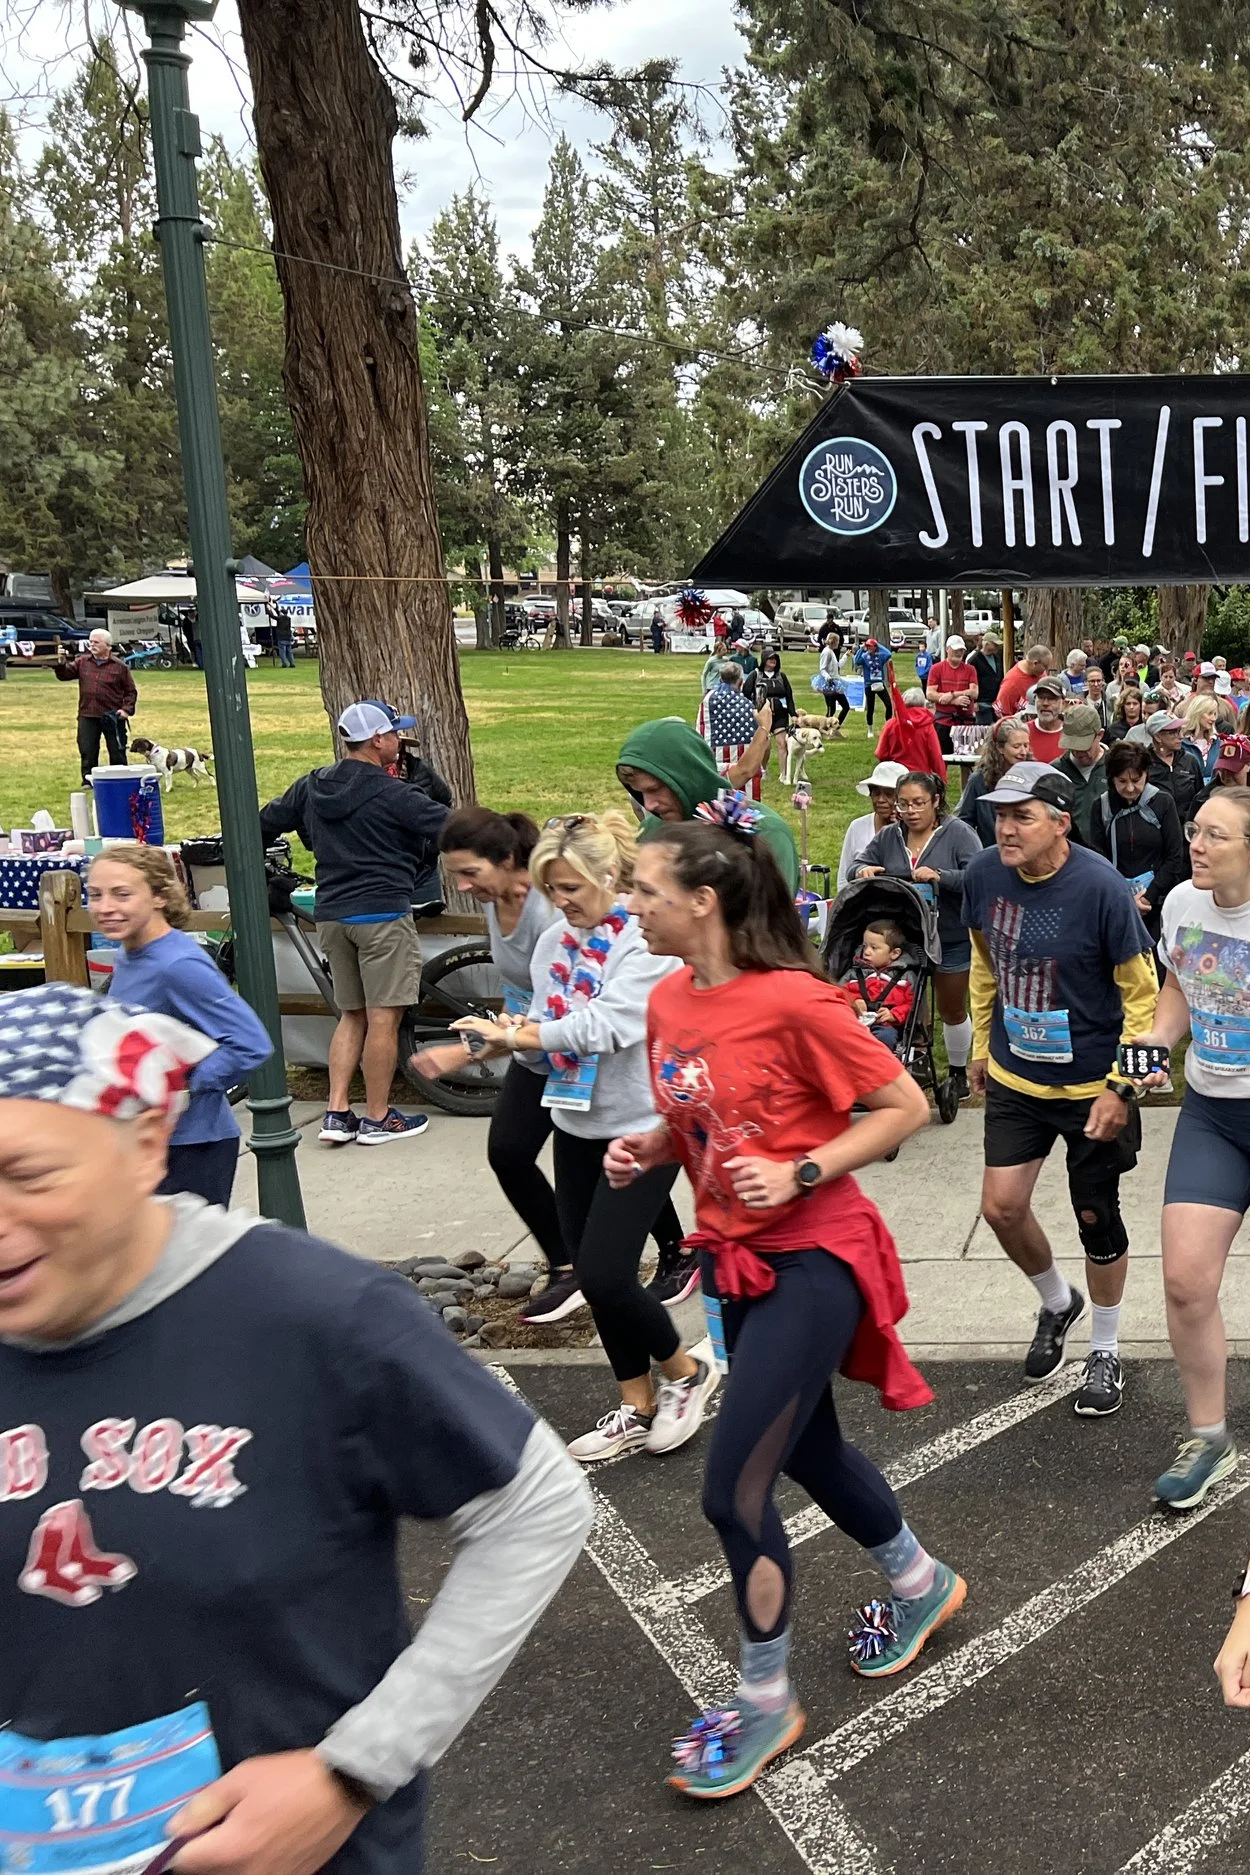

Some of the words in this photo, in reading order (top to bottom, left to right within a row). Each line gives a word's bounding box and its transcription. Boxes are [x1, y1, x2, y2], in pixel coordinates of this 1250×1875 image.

[810, 469, 884, 504] SISTERS
[830, 497, 869, 522] RUN
[1021, 1026, 1047, 1041] 362
[1203, 1029, 1228, 1049] 361
[79, 1416, 254, 1508] SOX
[44, 1774, 138, 1834] 177
